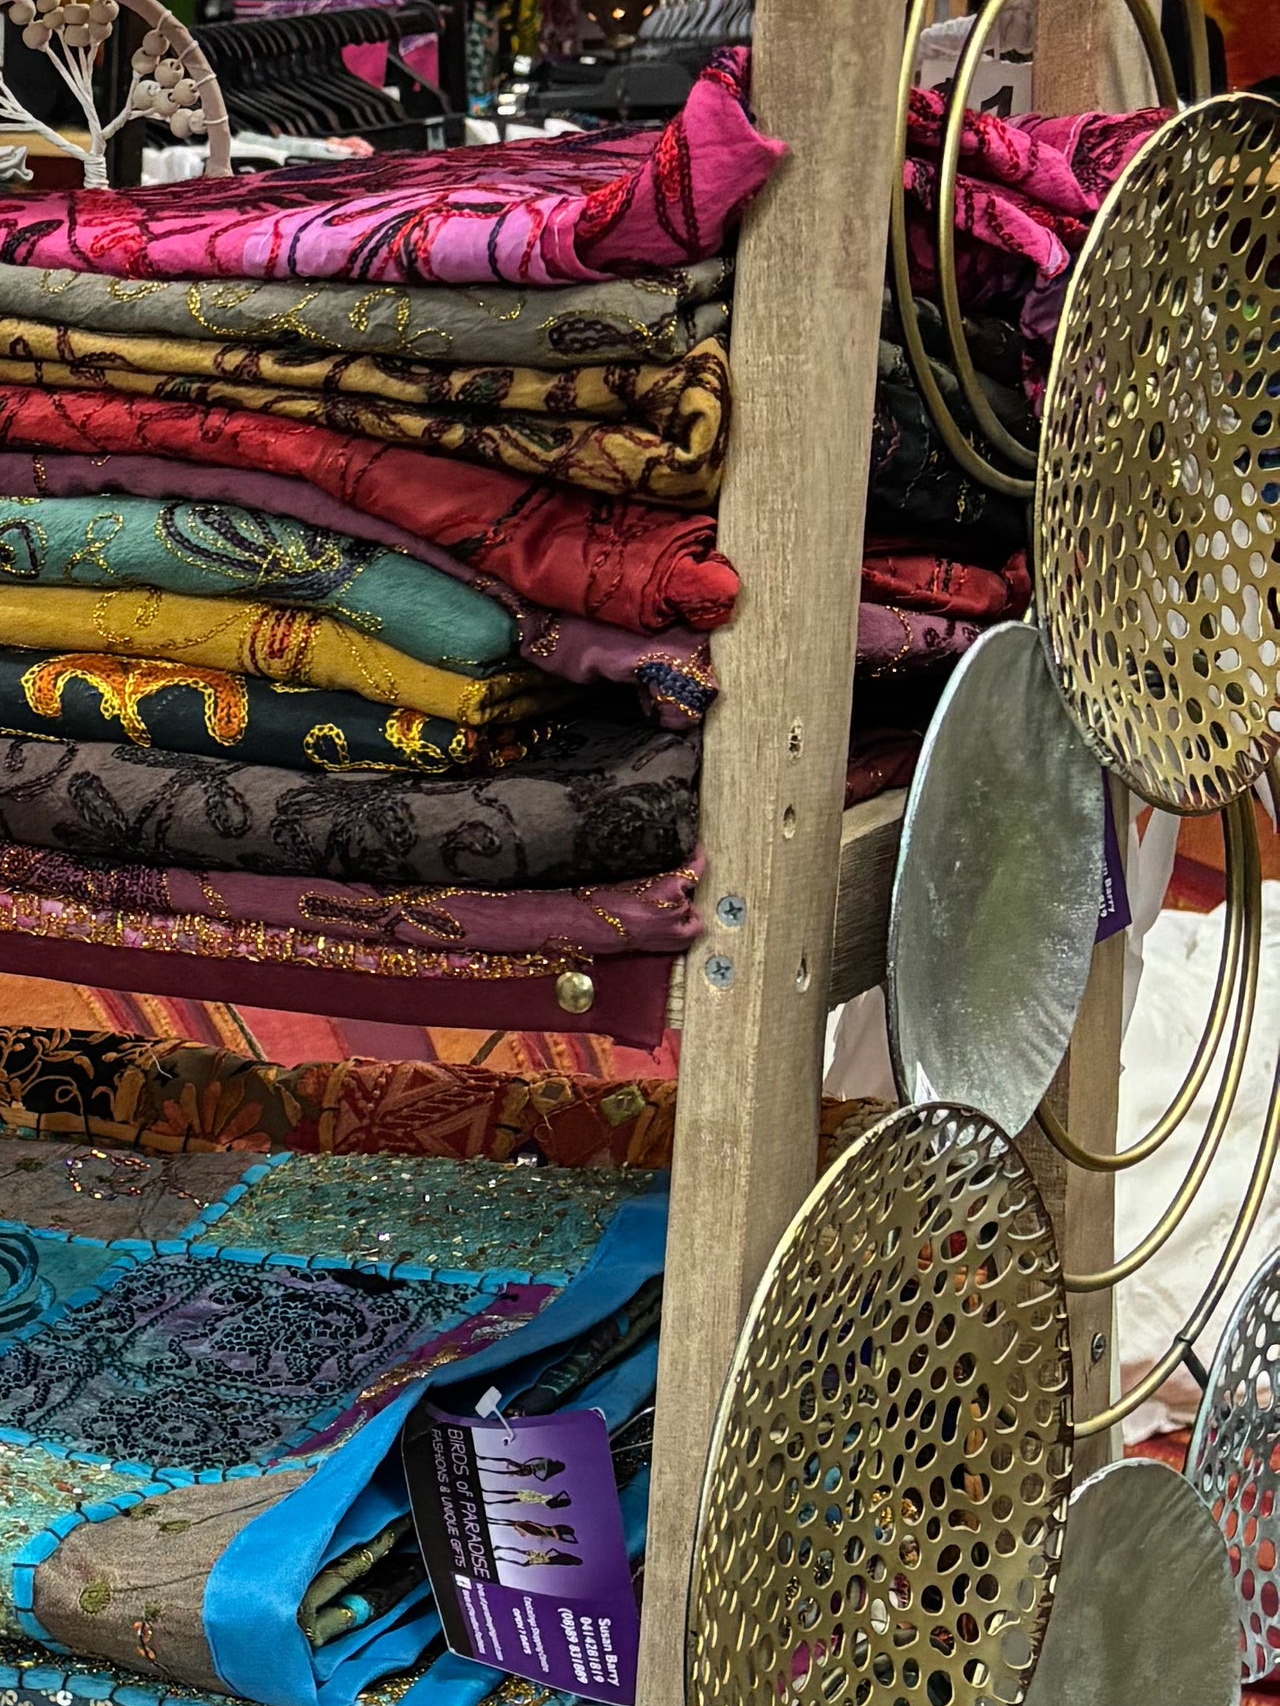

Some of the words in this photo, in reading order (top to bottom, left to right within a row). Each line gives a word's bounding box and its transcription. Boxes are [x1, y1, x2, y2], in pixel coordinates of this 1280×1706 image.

[447, 1428, 470, 1480] BIRDS
[460, 1499, 491, 1580] PARADISE
[598, 1616, 613, 1648] Susan
[605, 1649, 621, 1687] Barry
